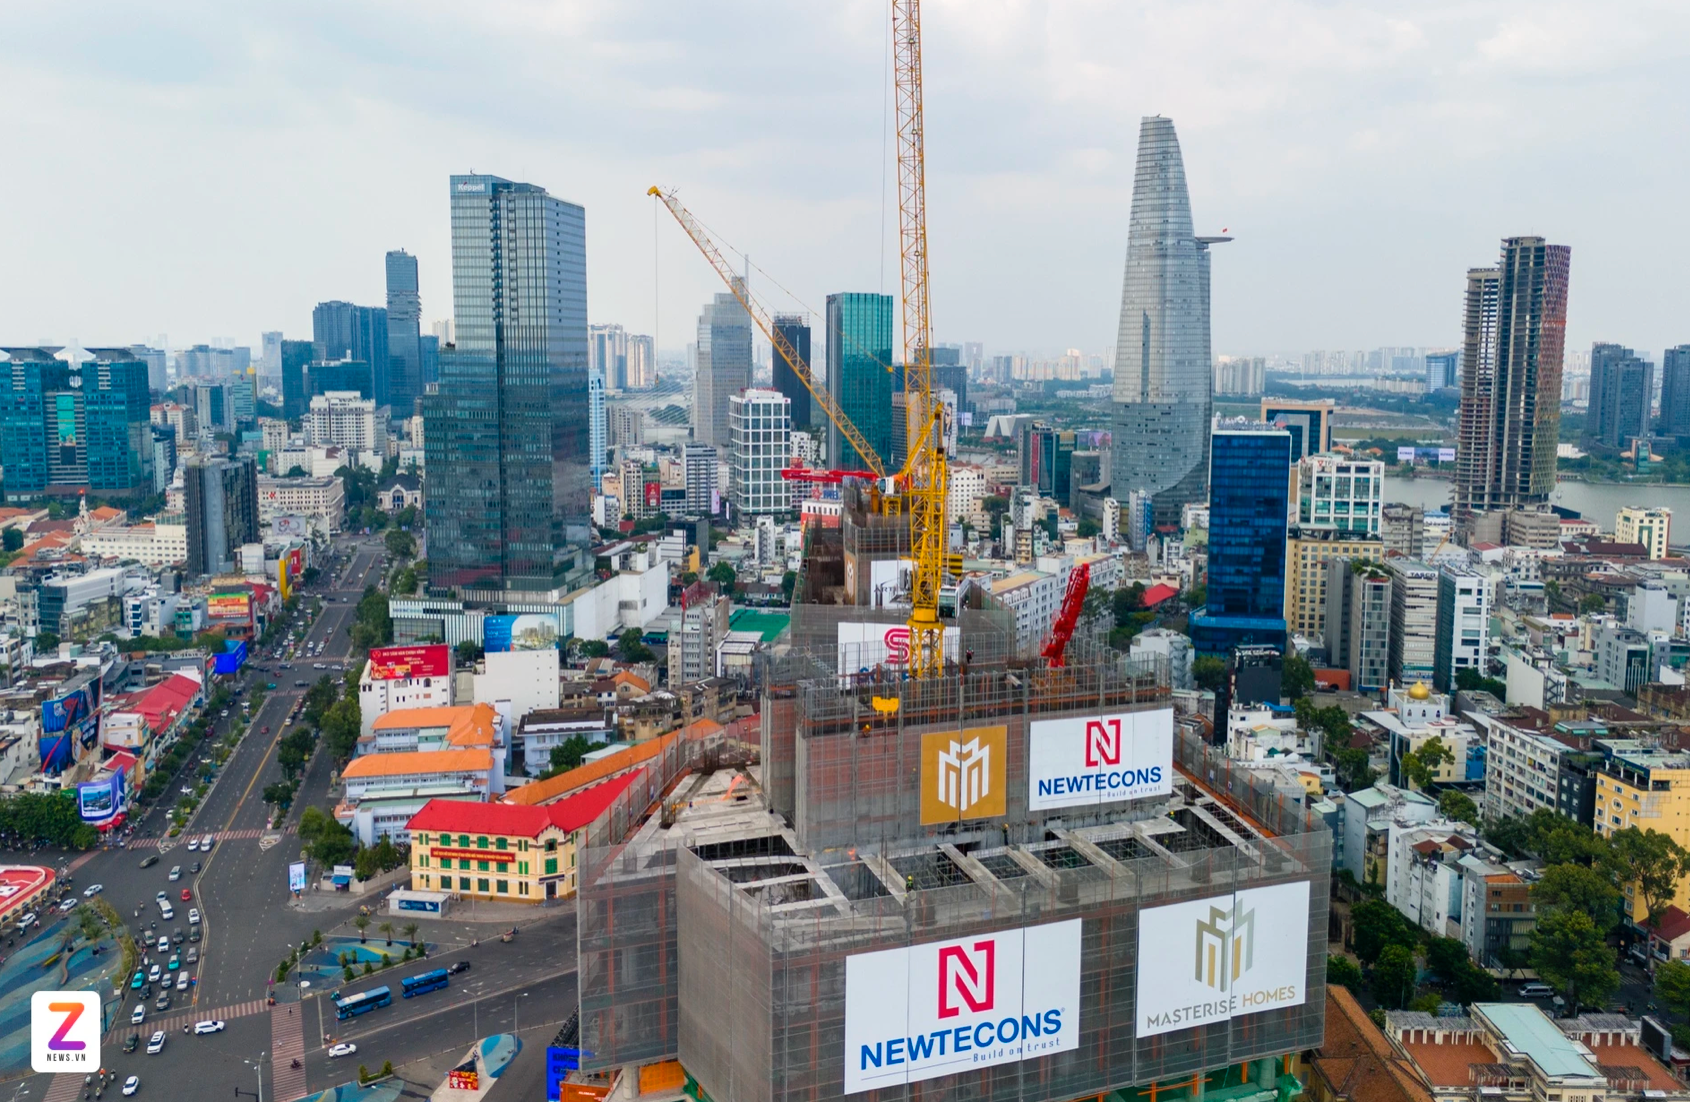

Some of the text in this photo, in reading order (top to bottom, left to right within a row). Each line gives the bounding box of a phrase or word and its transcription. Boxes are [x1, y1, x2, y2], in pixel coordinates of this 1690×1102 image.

[458, 183, 485, 192] Keppel
[1039, 766, 1162, 796] NEWTECONS
[1107, 785, 1161, 798] Build on trust
[1147, 985, 1296, 1029] MASTERISE HOMES
[861, 1009, 1062, 1070] NEWTECONS
[973, 1037, 1060, 1062] Build on trust
